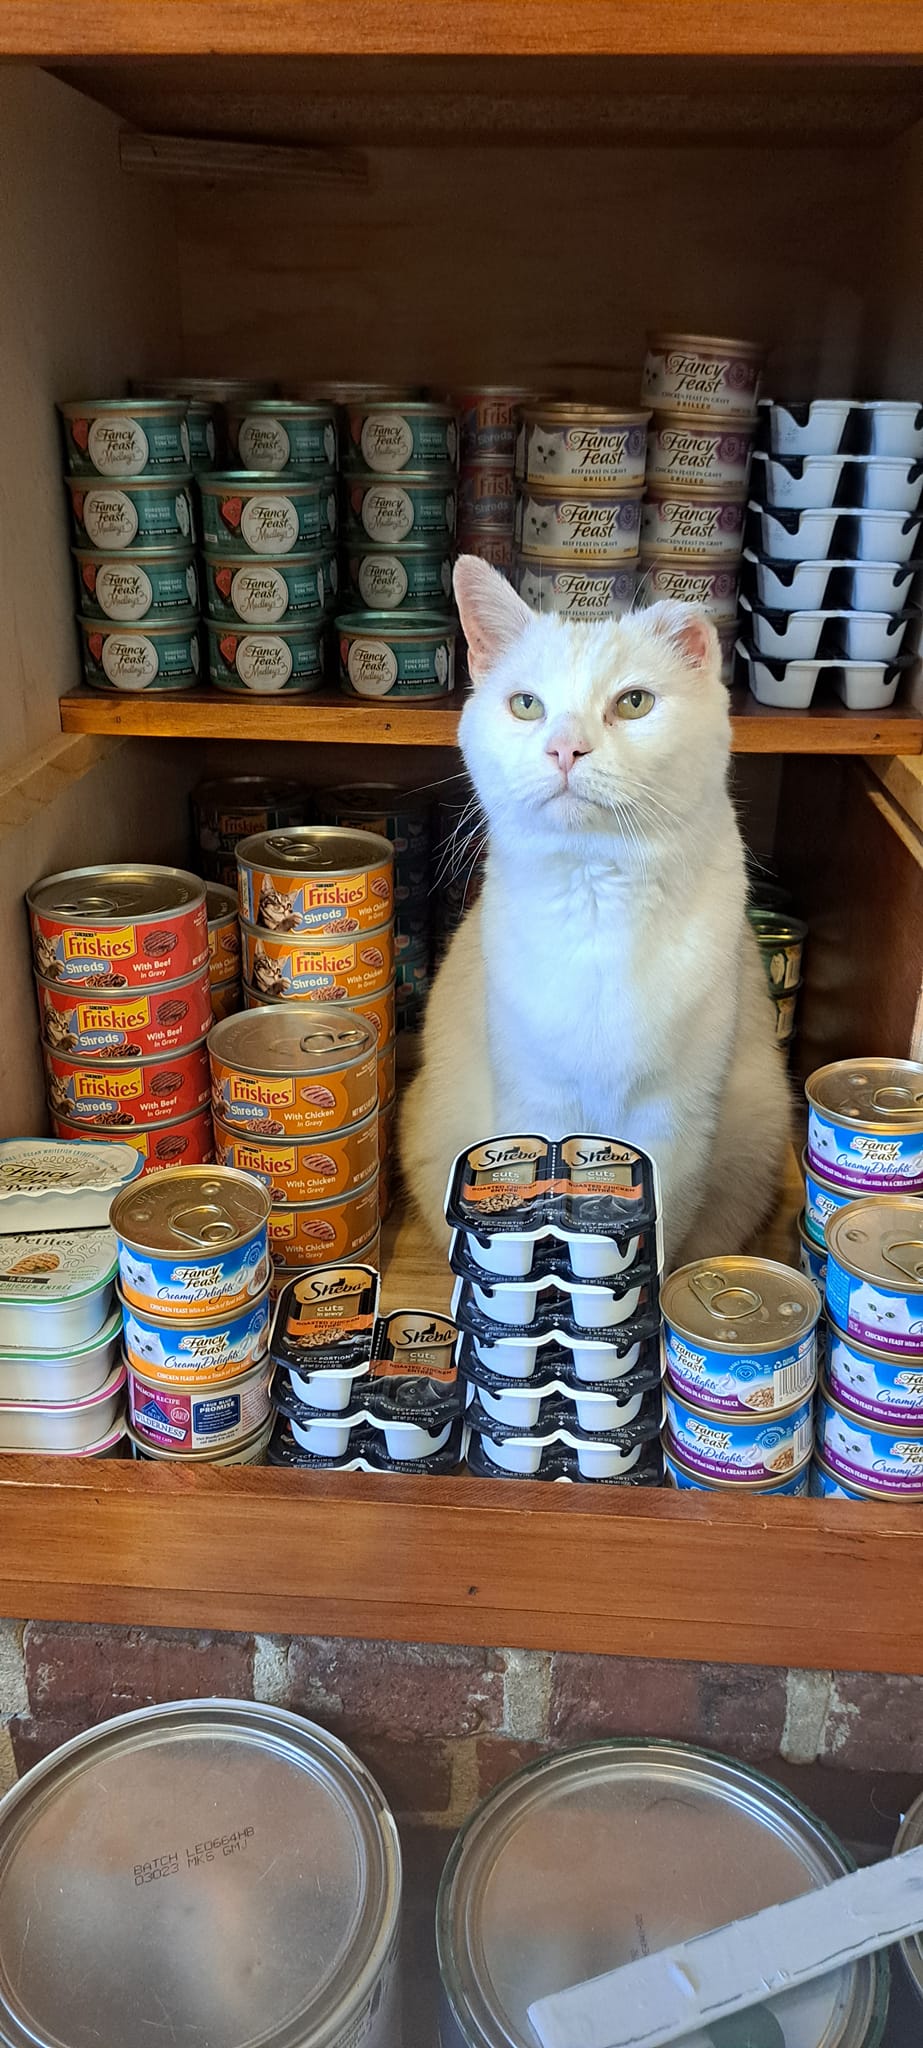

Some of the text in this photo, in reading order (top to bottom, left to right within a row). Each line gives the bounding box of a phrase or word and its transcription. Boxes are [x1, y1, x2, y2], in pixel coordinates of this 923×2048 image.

[669, 355, 727, 380] Fancy
[675, 374, 724, 393] Feast
[96, 428, 136, 441] Fancy
[247, 428, 278, 440] Fancy
[369, 424, 403, 437] Fancy
[107, 440, 136, 451] Feast
[253, 439, 279, 449] Feast
[376, 435, 402, 446] Feast
[569, 430, 628, 451] Fancy
[662, 431, 719, 456] Fancy
[579, 449, 624, 467] Feast
[669, 448, 716, 468] Feast
[89, 500, 126, 513] Fancy
[369, 496, 403, 508] Fancy
[99, 512, 125, 522] Feast
[251, 507, 289, 519] Fancy
[376, 507, 403, 517] Feast
[560, 503, 619, 525] Fancy
[663, 502, 720, 526] Fancy
[261, 518, 288, 529] Feast
[570, 521, 615, 539] Feast
[671, 520, 716, 538] Feast
[365, 566, 396, 577] Fancy
[103, 573, 140, 586] Fancy
[240, 577, 277, 590] Fancy
[373, 575, 396, 585] Feast
[557, 574, 613, 596] Fancy
[657, 572, 714, 593] Fancy
[112, 584, 140, 595] Feast
[249, 589, 276, 600] Feast
[568, 592, 611, 609] Feast
[110, 643, 146, 655] Fancy
[245, 645, 282, 658] Fancy
[354, 649, 387, 661] Fancy
[119, 654, 146, 665] Feast
[254, 656, 281, 666] Feast
[360, 660, 386, 671] Feast
[309, 886, 364, 907] Friskies
[304, 910, 342, 924] Shreds
[359, 907, 373, 916] With
[69, 937, 132, 957] Friskies
[65, 961, 105, 974] Shreds
[132, 958, 171, 972] With Beef
[296, 954, 351, 973] Friskies
[148, 969, 166, 979] Gravy
[347, 974, 362, 984] With
[293, 976, 329, 990] Shreds
[83, 1009, 146, 1029] Friskies
[79, 1033, 119, 1046] Shreds
[147, 1027, 182, 1041] With Beef
[161, 1037, 178, 1047] Gravy
[79, 1078, 139, 1097] Friskies
[233, 1081, 289, 1104] Friskies
[76, 1101, 112, 1112] Shreds
[140, 1098, 177, 1111] With Beef
[231, 1105, 264, 1116] Shreds
[155, 1108, 172, 1117] Gravy
[284, 1109, 335, 1121] With Chicken
[305, 1120, 323, 1128] Gravy
[855, 1138, 900, 1152] Fancy
[237, 1150, 292, 1173] Friskies
[478, 1149, 538, 1167] Sheba
[571, 1149, 630, 1166] Sheba
[863, 1150, 898, 1161] Feast
[0, 1164, 80, 1179] Fancy
[146, 1166, 164, 1174] With
[836, 1154, 911, 1180] Creamy Delights
[587, 1170, 615, 1178] cuts
[286, 1176, 336, 1188] With Chicken
[307, 1186, 325, 1194] Gravy
[13, 1236, 74, 1246] Petites
[305, 1242, 335, 1251] Chicken
[306, 1251, 323, 1259] Gravy
[175, 1265, 222, 1280] Fancy
[185, 1277, 220, 1289] Feast
[157, 1284, 234, 1304] Creamy Delights
[304, 1280, 361, 1301] Sheba
[150, 1304, 173, 1313] CHICKEN
[182, 1334, 228, 1348] Fancy
[396, 1327, 452, 1346] Sheba
[864, 1330, 904, 1346] CHICKEN FEAST
[192, 1346, 226, 1358] Feast
[674, 1340, 705, 1364] Fancy
[164, 1351, 239, 1372] Creamy Delights
[678, 1354, 705, 1373] Feast
[156, 1372, 195, 1382] CHICKEN FEAST
[681, 1368, 717, 1391] Delights
[136, 1383, 180, 1405] SALMON RECIPE
[701, 1394, 738, 1407] CREAMY SAUCE
[876, 1390, 916, 1410] Creamy
[200, 1401, 235, 1414] PROMISE
[136, 1411, 184, 1439] WILDERNESS
[688, 1421, 730, 1440] Fancy
[697, 1434, 729, 1449] Feast
[677, 1431, 743, 1467] Creamy Delights
[726, 1467, 747, 1475] CREAMY
[835, 1460, 868, 1480] CHICKEN FEAST
[872, 1460, 911, 1480] Creamy
[223, 1839, 248, 1857] GMJ
[134, 1852, 178, 1876] BATCH
